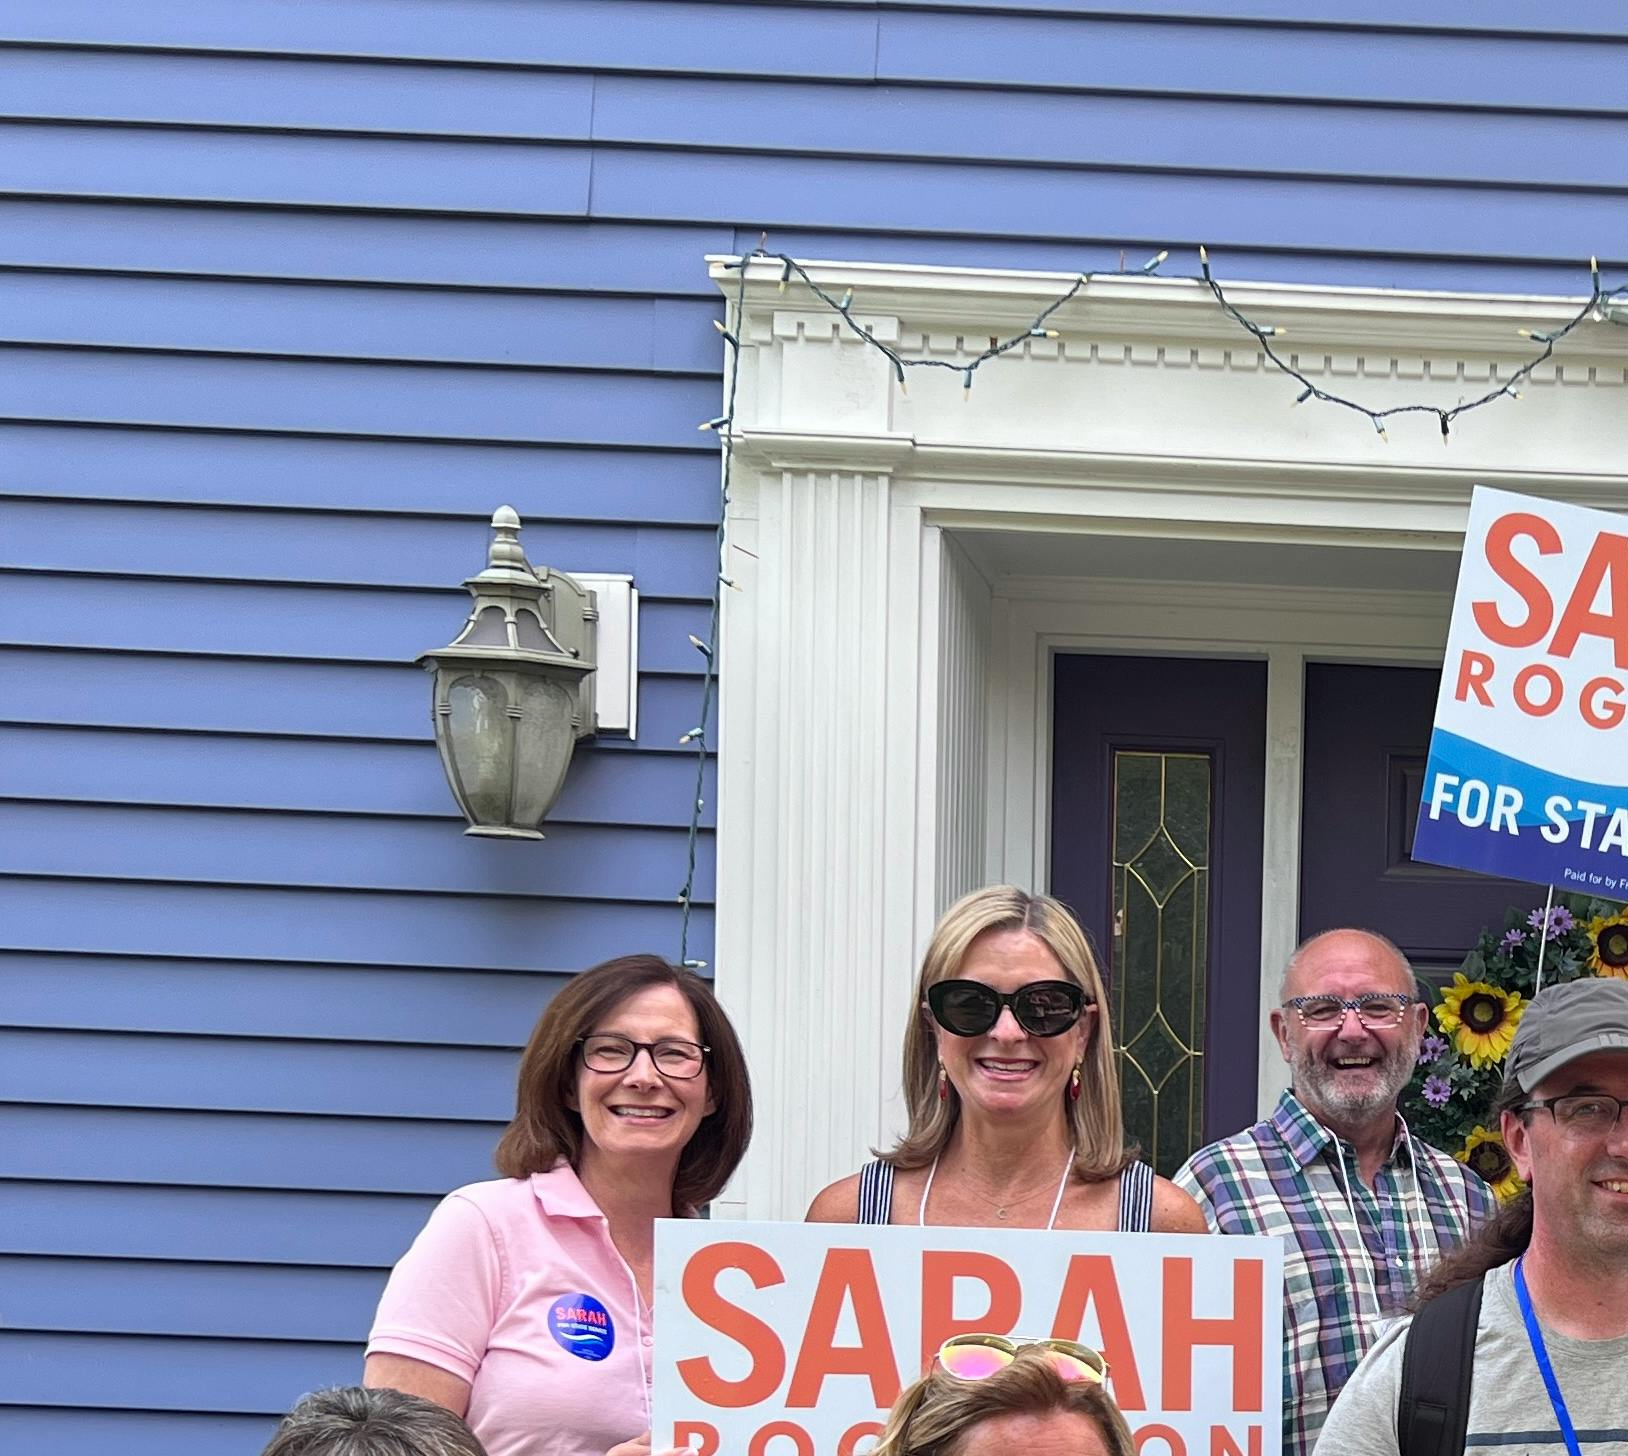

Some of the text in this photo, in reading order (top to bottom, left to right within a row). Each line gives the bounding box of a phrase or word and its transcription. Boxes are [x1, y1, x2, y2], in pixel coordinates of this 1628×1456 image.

[1428, 773, 1523, 836] FOR
[1564, 868, 1586, 882] Paid
[1589, 872, 1602, 884] for
[1605, 876, 1616, 889] by
[556, 1307, 607, 1326] SARAH
